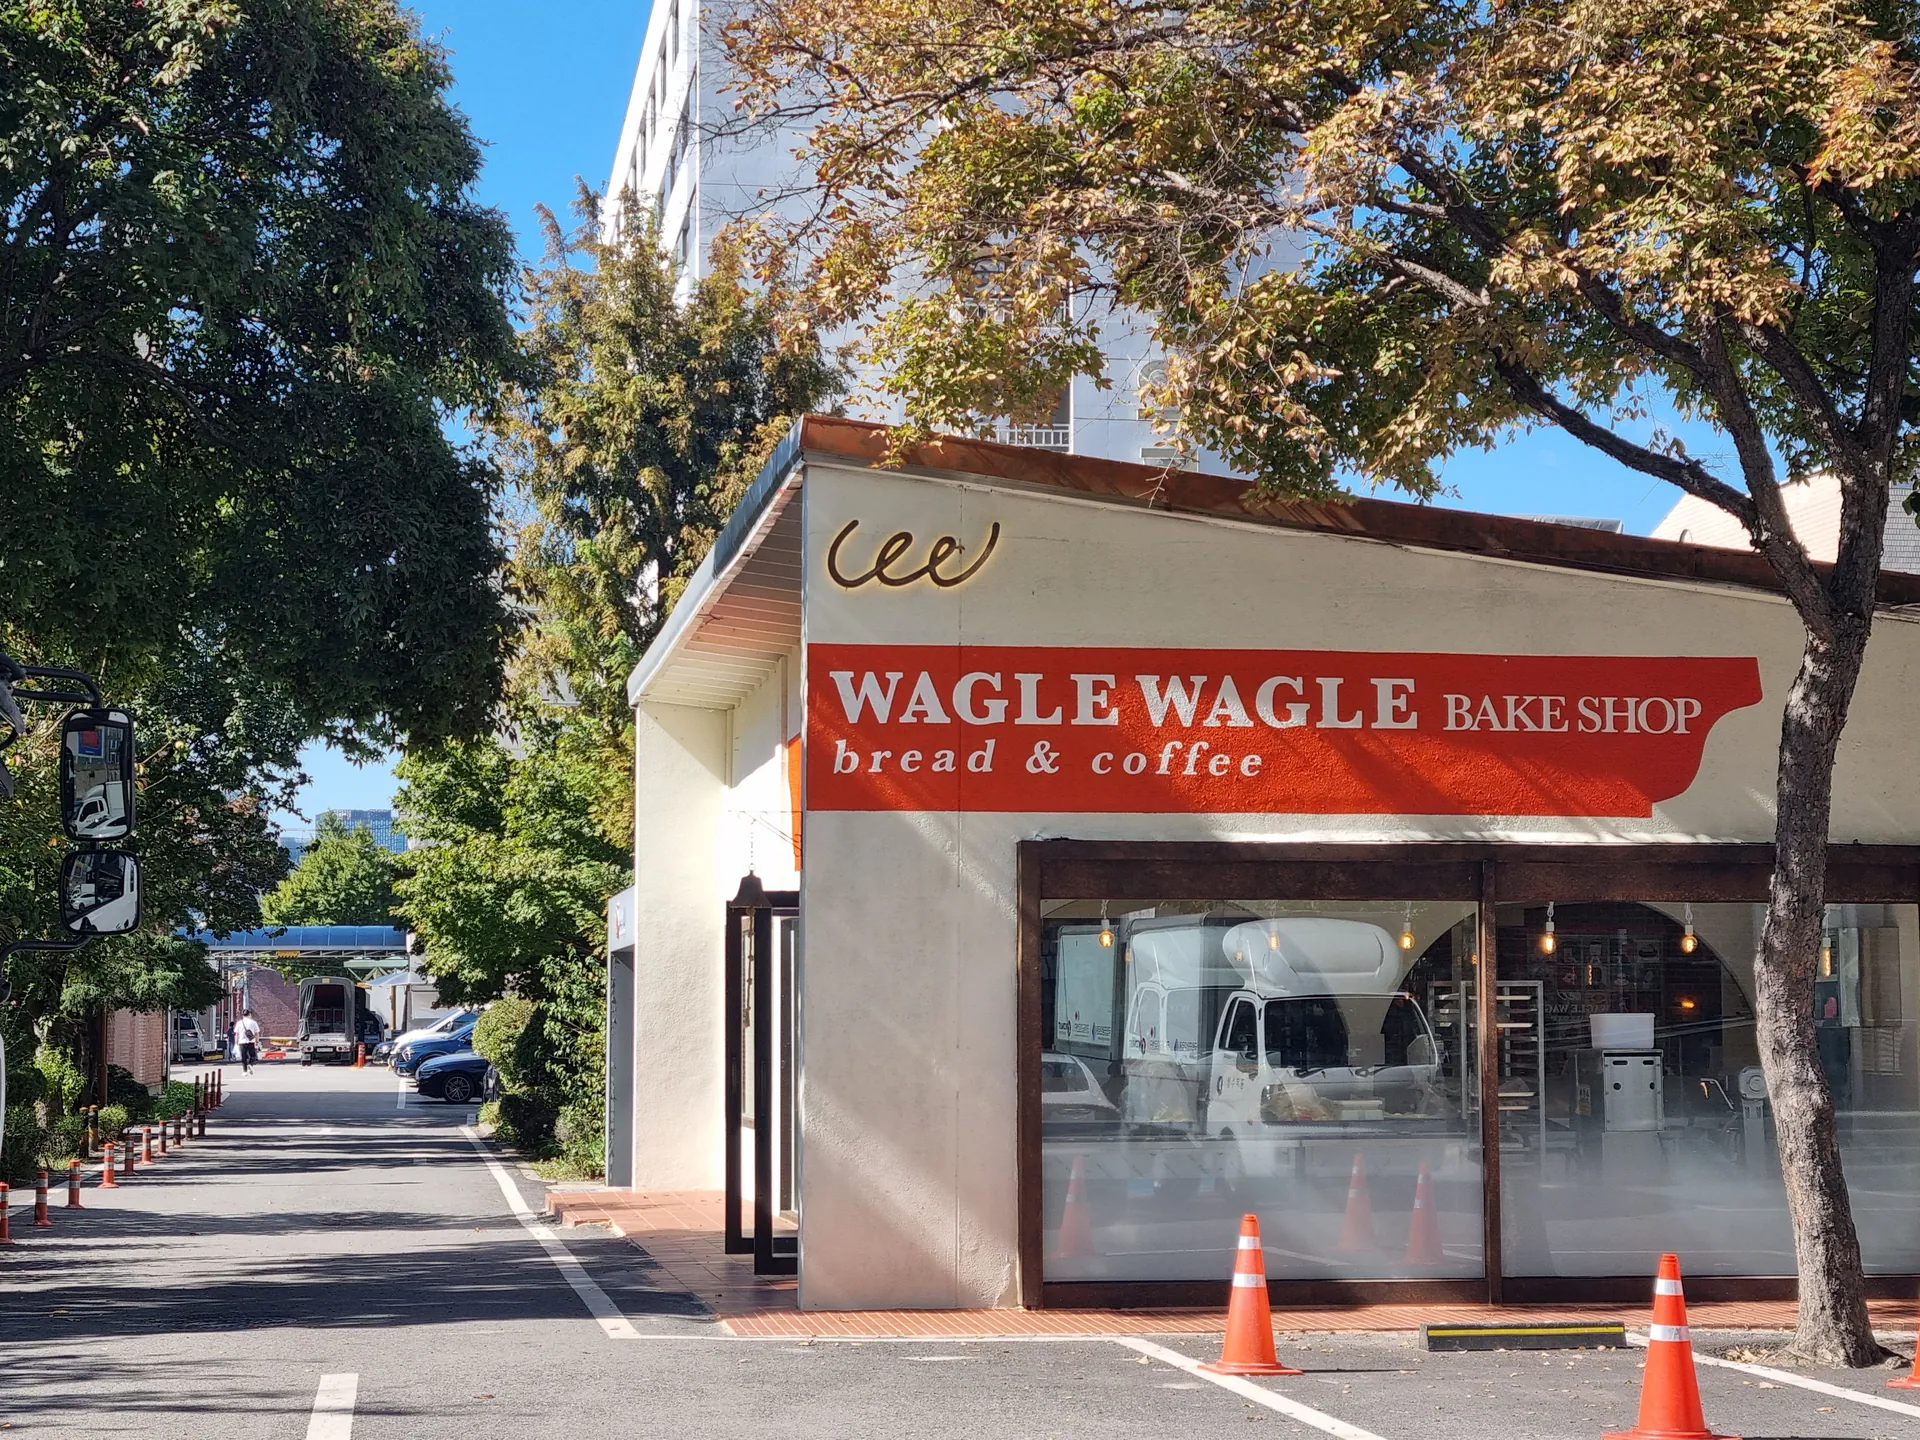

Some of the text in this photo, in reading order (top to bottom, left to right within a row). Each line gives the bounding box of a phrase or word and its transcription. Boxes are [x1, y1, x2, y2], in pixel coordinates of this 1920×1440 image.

[829, 670, 1702, 734] WAGLE WAGLE BAKE SHOP
[833, 738, 1262, 777] bread & coffee
